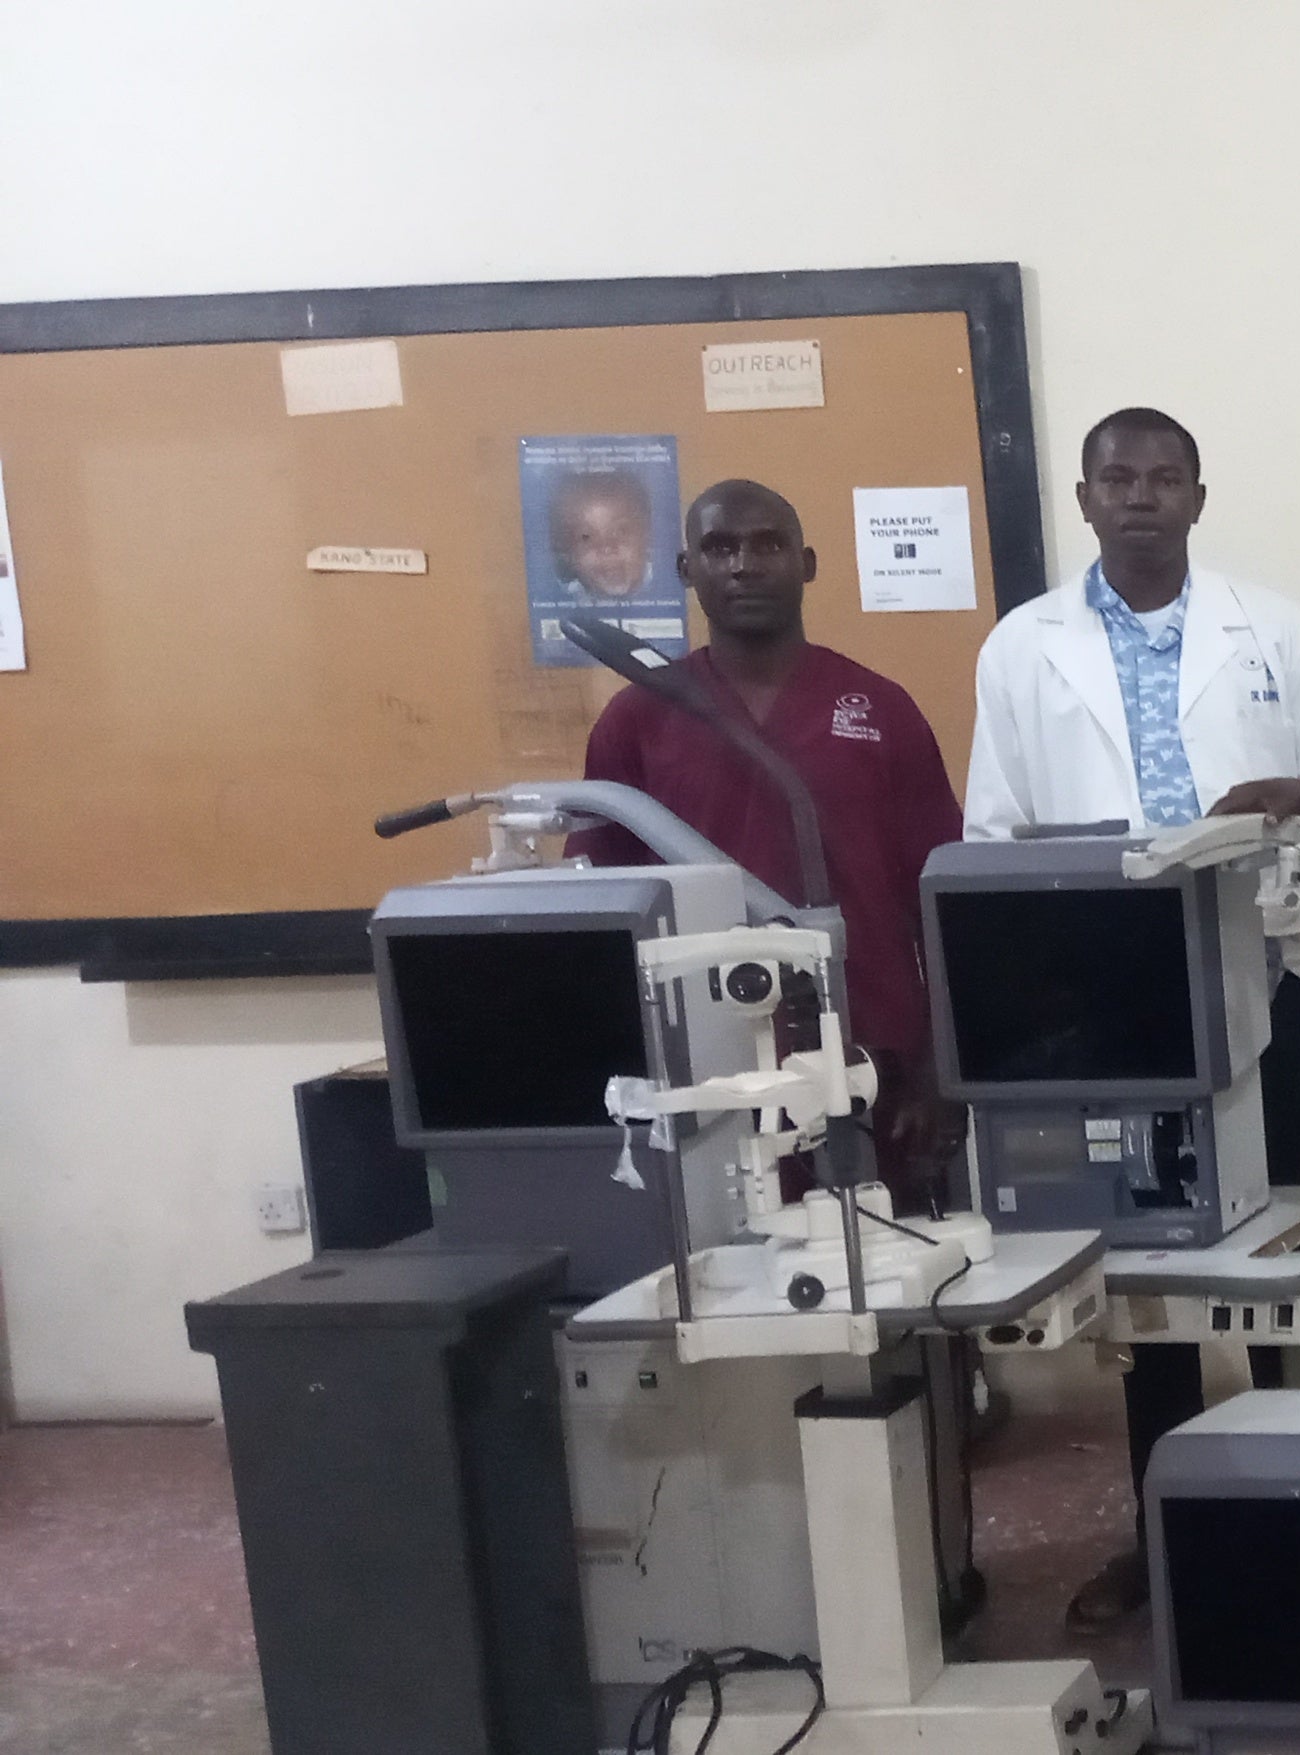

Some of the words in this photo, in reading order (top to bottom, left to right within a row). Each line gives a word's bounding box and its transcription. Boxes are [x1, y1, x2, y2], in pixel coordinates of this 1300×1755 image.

[708, 355, 812, 375] OUTREACH
[870, 517, 908, 526] PLEASE
[911, 516, 932, 525] PUT
[870, 529, 899, 537] YOUR
[903, 528, 939, 537] PHONE
